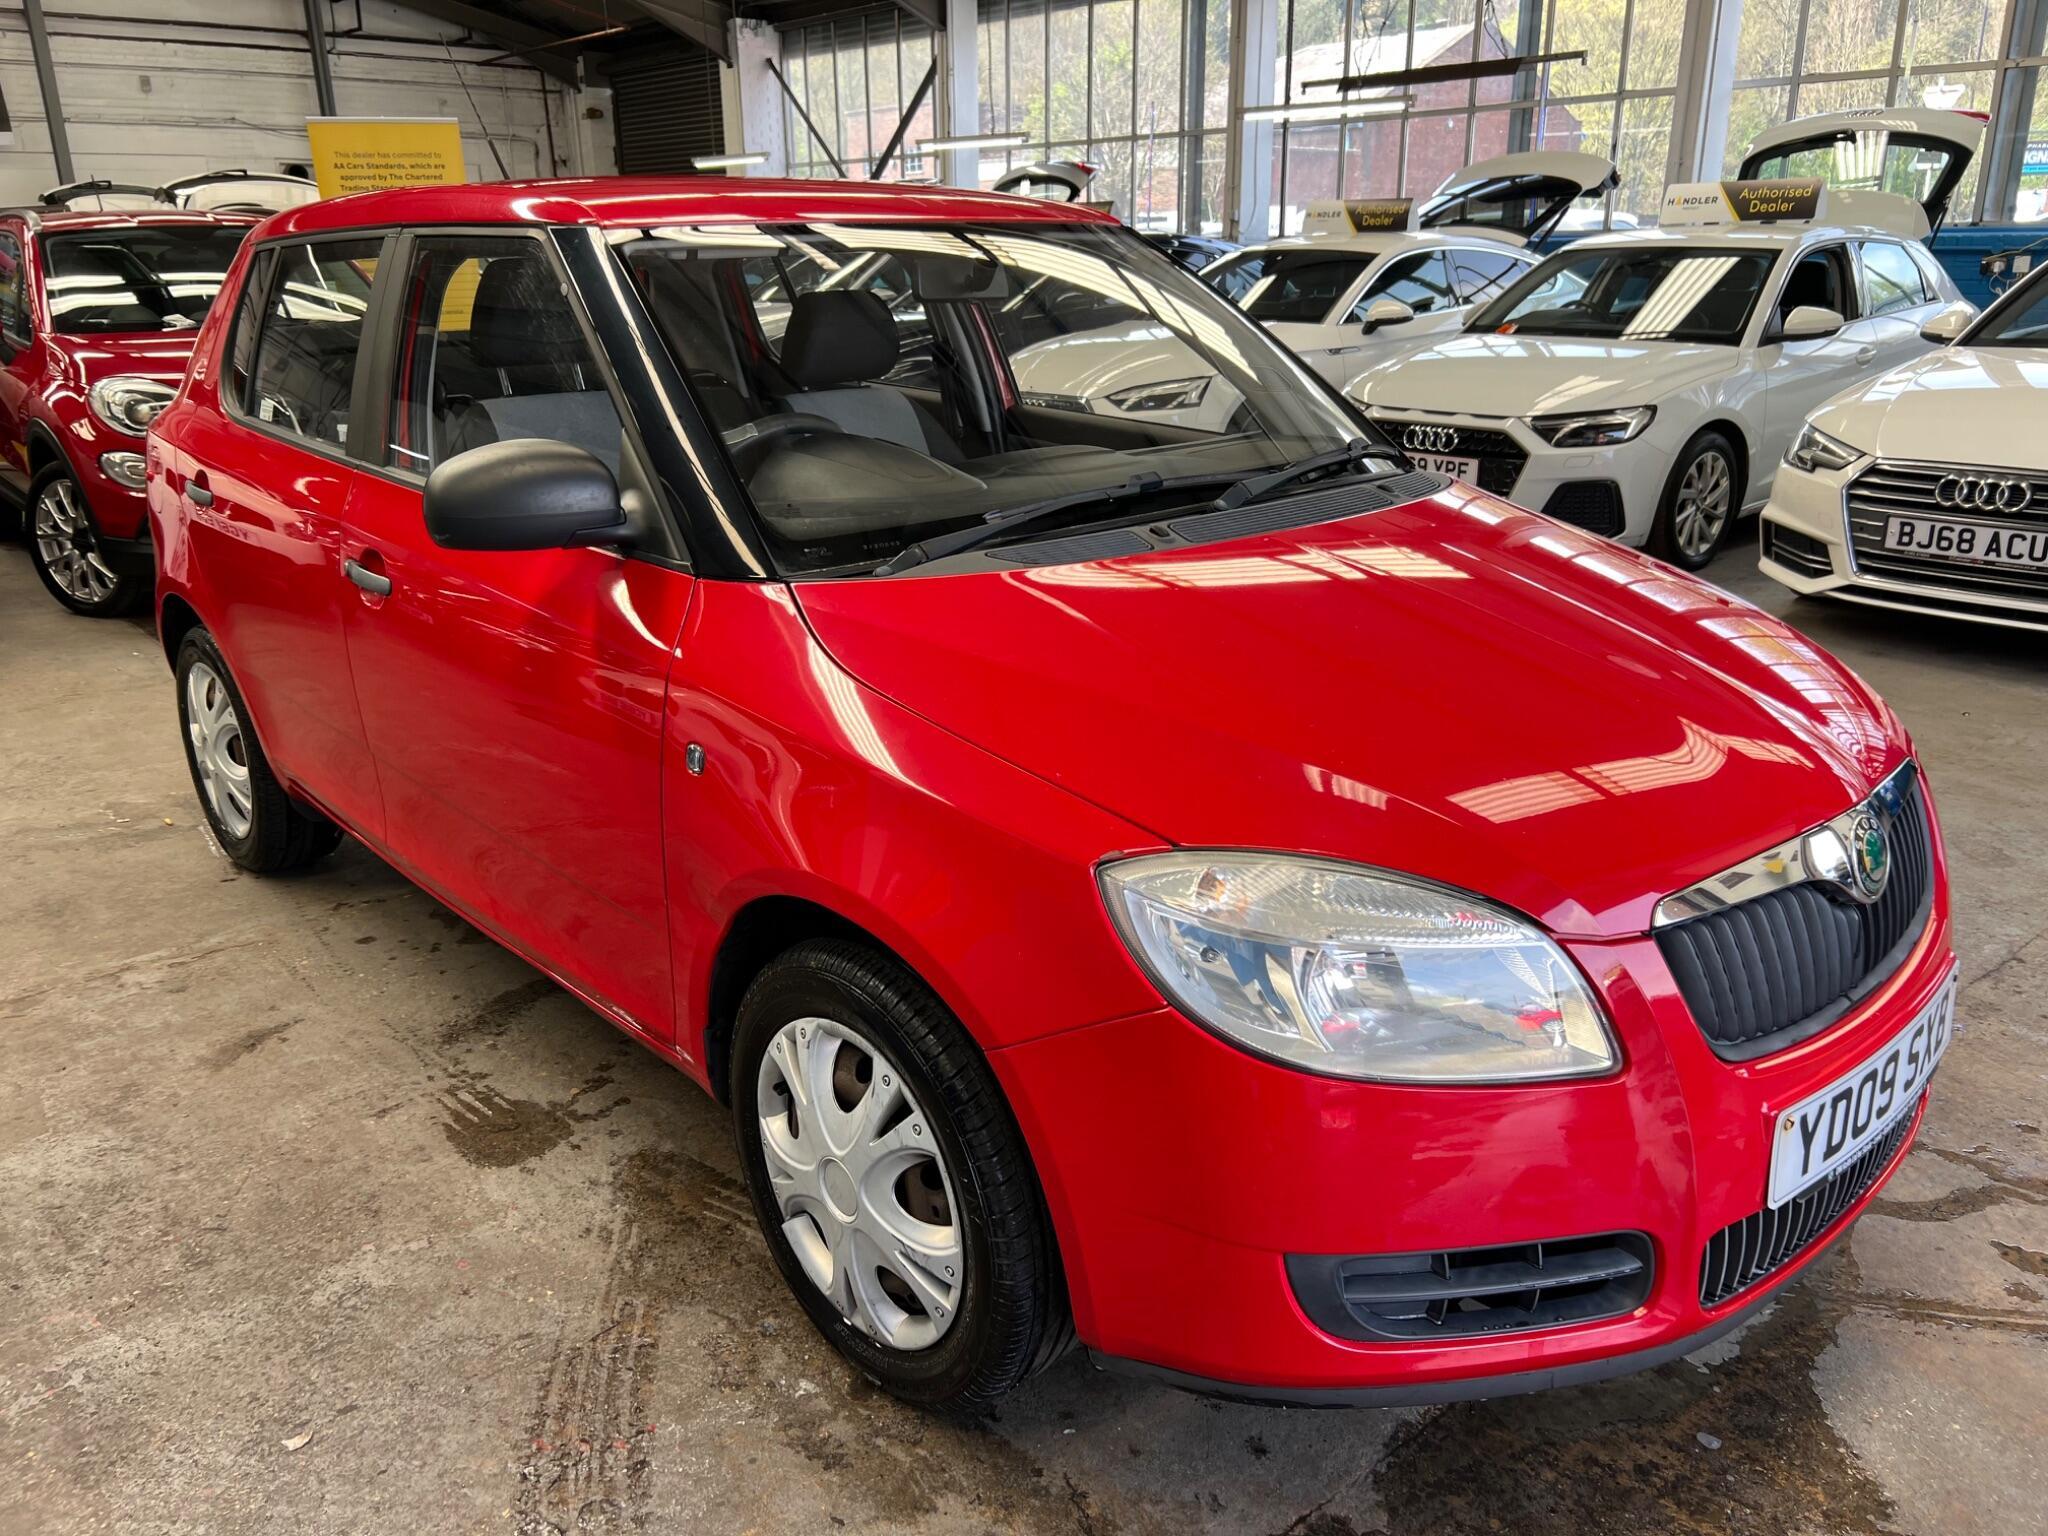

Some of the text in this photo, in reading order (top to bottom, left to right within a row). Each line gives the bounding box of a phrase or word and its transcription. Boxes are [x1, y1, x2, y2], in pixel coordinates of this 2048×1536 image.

[392, 151, 432, 159] committed
[2024, 150, 2048, 164] IGN
[378, 173, 387, 182] by
[405, 173, 443, 181] Chartered
[1739, 184, 1813, 200] Authorised
[1355, 204, 1406, 215] Authorised
[1749, 200, 1795, 213] Dealer
[1362, 215, 1394, 226] Dealer
[1896, 521, 2048, 563] BJ68 ACU
[1800, 1049, 1900, 1177] YD09
[1903, 987, 1950, 1093] SXB
